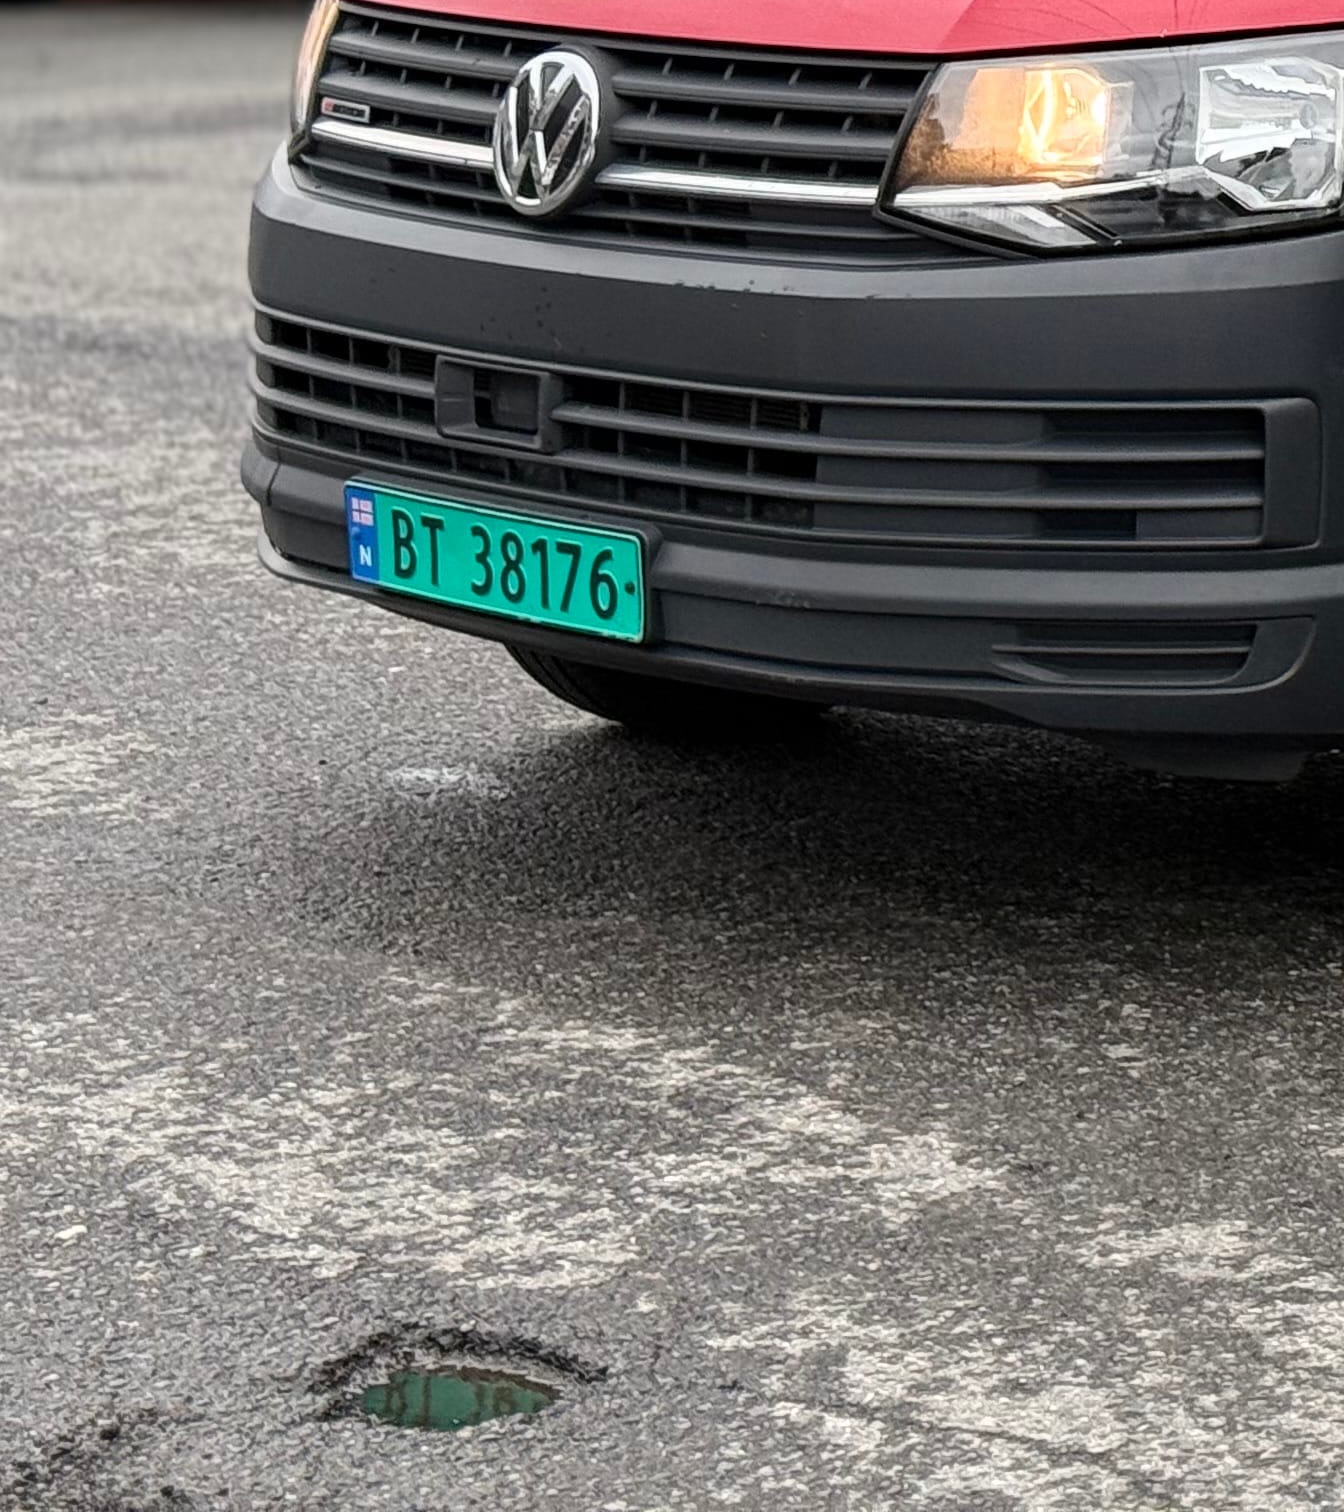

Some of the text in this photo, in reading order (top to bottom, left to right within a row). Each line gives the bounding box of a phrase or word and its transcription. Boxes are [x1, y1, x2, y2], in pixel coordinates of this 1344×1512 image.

[358, 544, 373, 568] N
[391, 507, 619, 620] BT 38176
